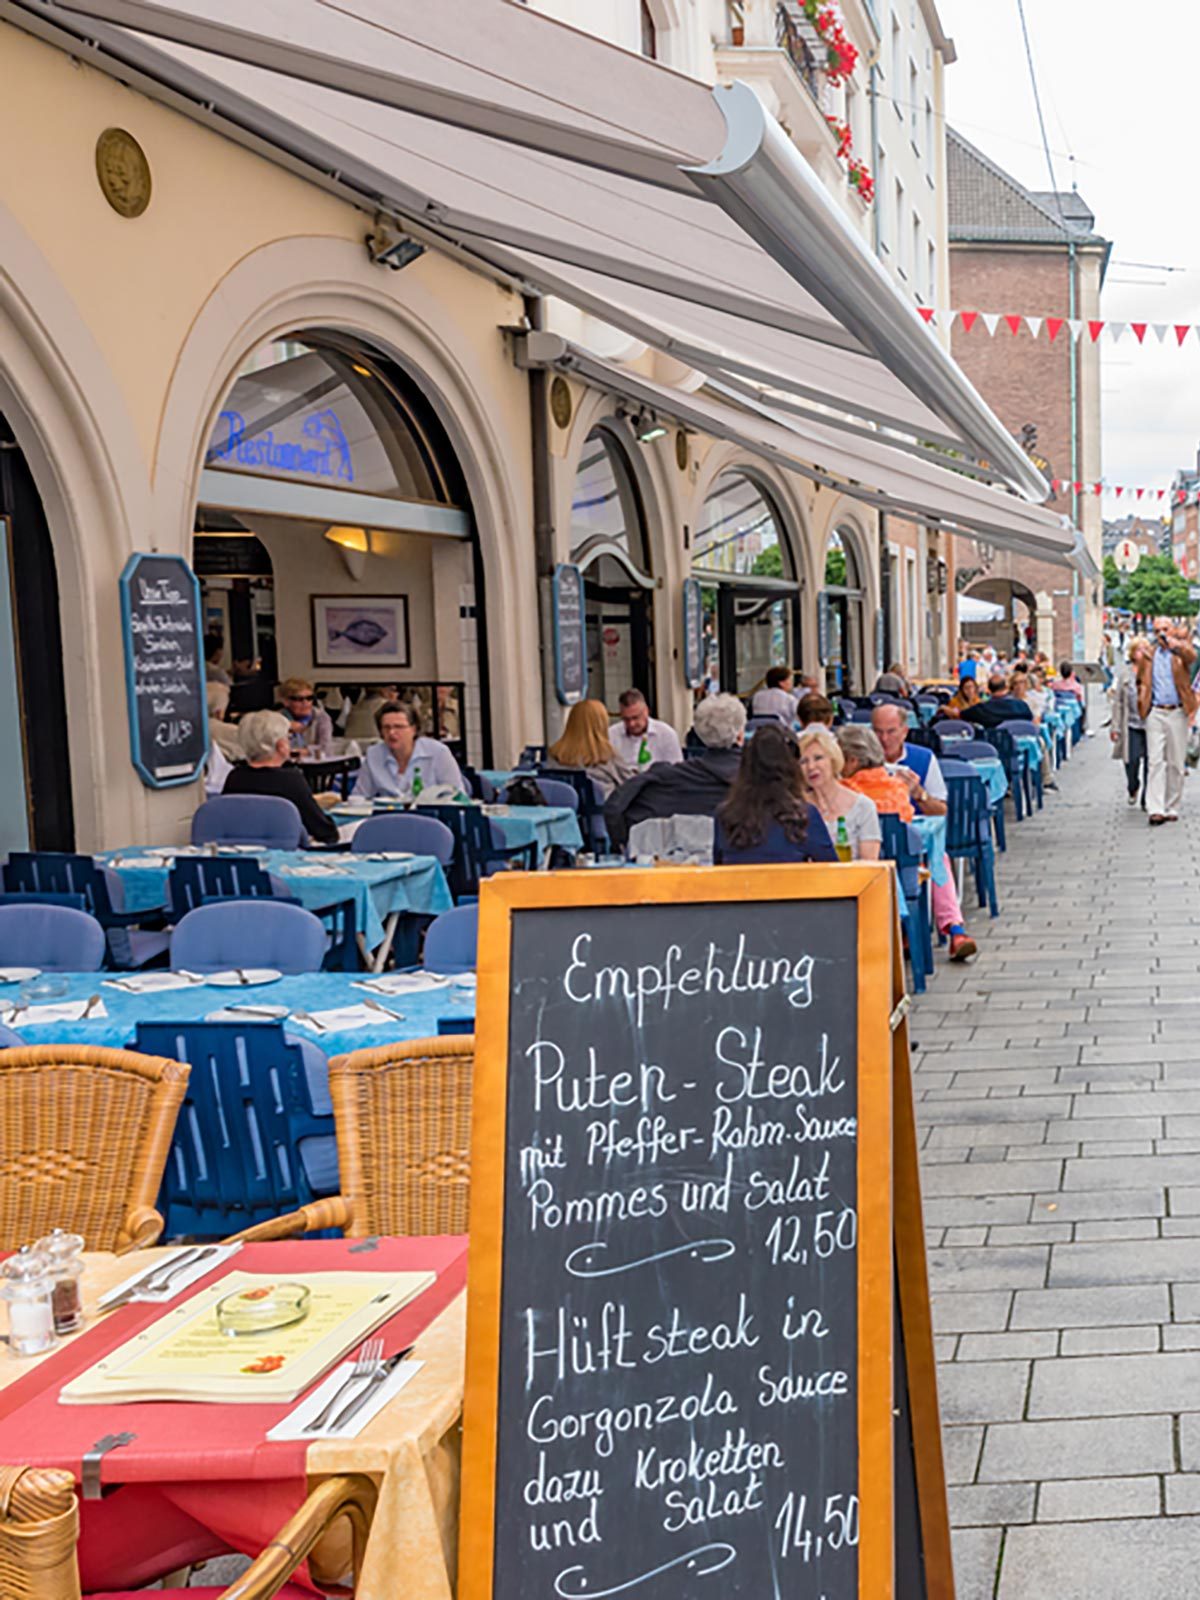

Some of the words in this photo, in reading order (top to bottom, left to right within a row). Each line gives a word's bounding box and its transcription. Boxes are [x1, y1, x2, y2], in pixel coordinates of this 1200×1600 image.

[564, 933, 815, 1028] Empfehlung
[715, 1025, 846, 1103] Steak
[520, 1133, 567, 1187] mit
[527, 1179, 668, 1231] Pommes
[681, 1151, 732, 1213] und
[744, 1151, 831, 1211] Salat
[764, 1207, 857, 1266] 12,50
[782, 1295, 829, 1341] in
[527, 1372, 738, 1457] Gorgonzola
[758, 1364, 848, 1408] Sauce
[523, 1450, 604, 1505] dazu
[635, 1427, 785, 1489] Kroketten
[530, 1497, 602, 1551] und
[663, 1472, 765, 1532] Salat
[774, 1491, 859, 1562] 14,50
